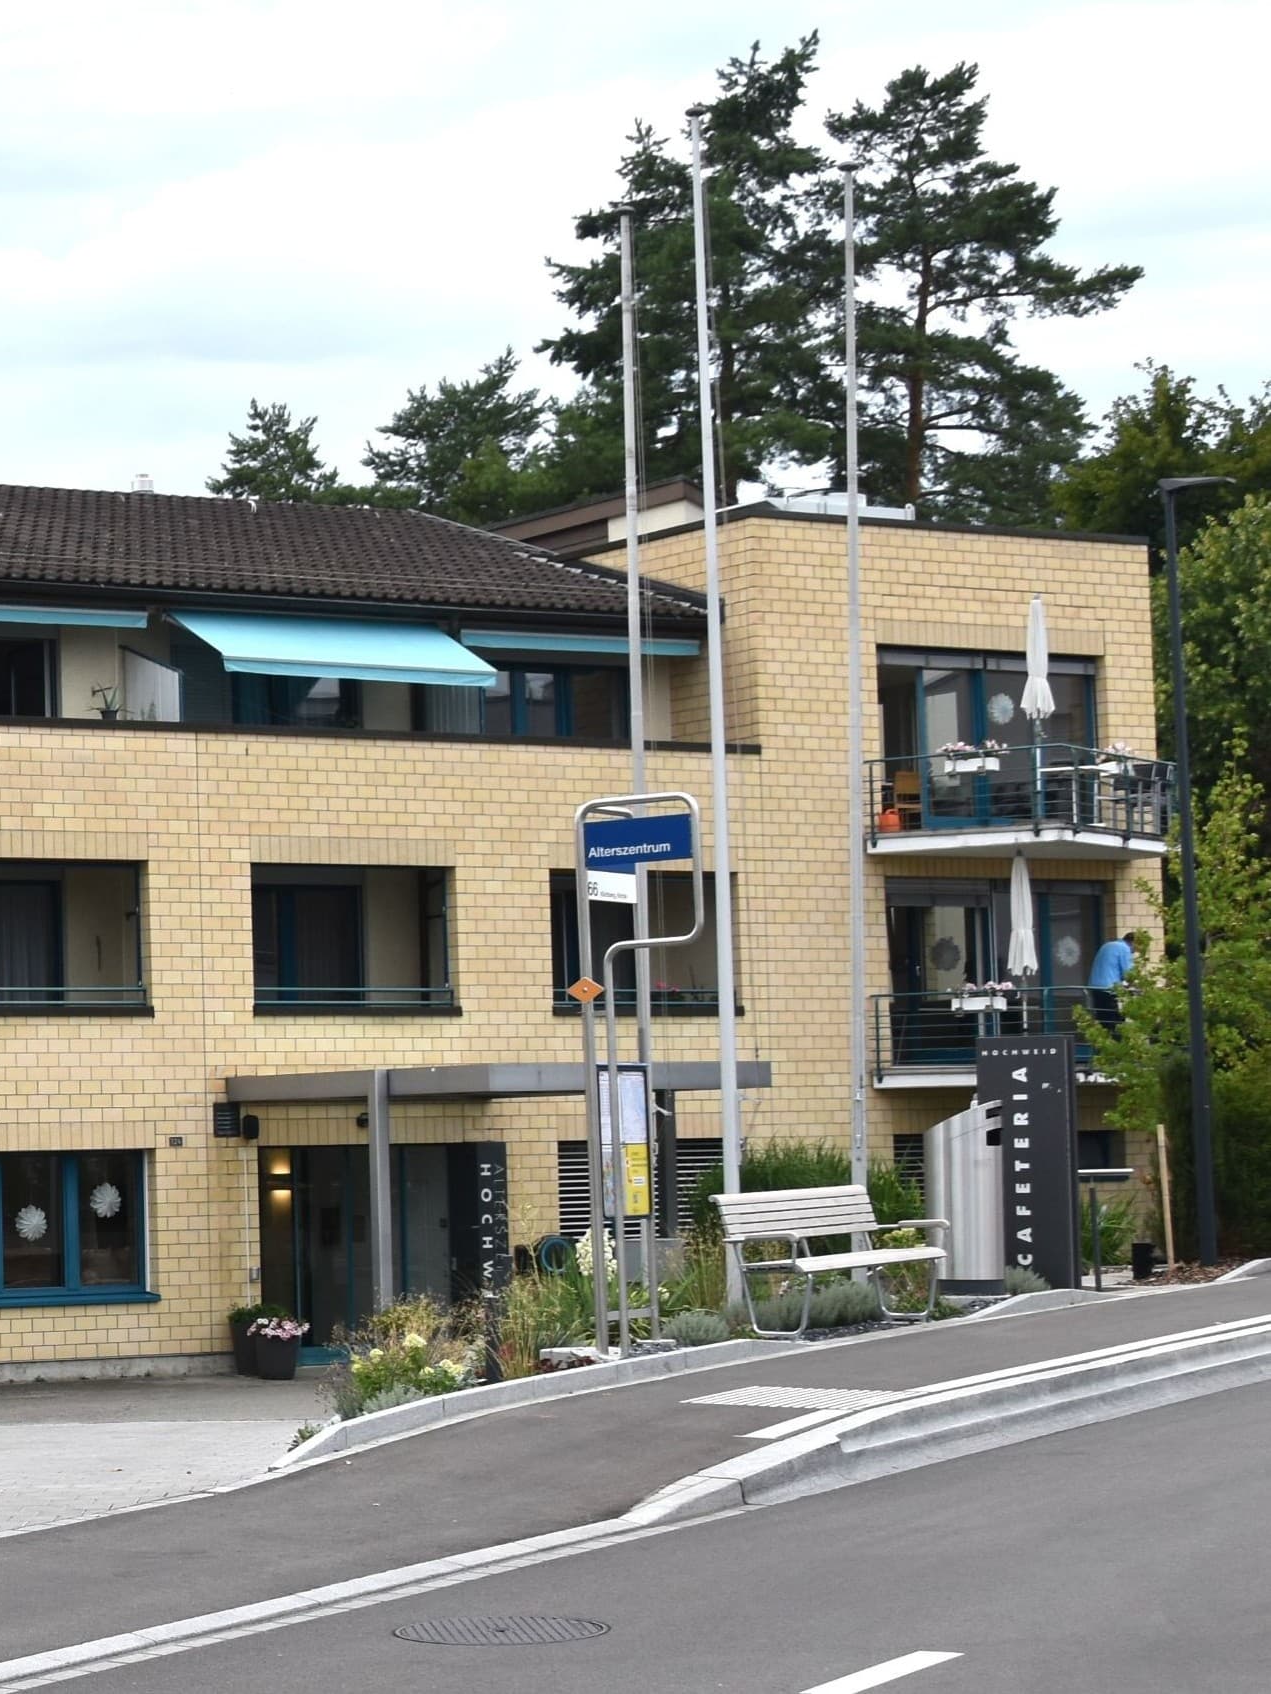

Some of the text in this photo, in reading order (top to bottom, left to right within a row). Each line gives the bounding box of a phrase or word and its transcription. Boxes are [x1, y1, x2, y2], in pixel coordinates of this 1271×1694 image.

[588, 842, 671, 859] Alterszentrum
[587, 881, 599, 897] 66
[981, 1047, 1057, 1057] HOCHWEID
[1012, 1066, 1033, 1266] CAFETERIA
